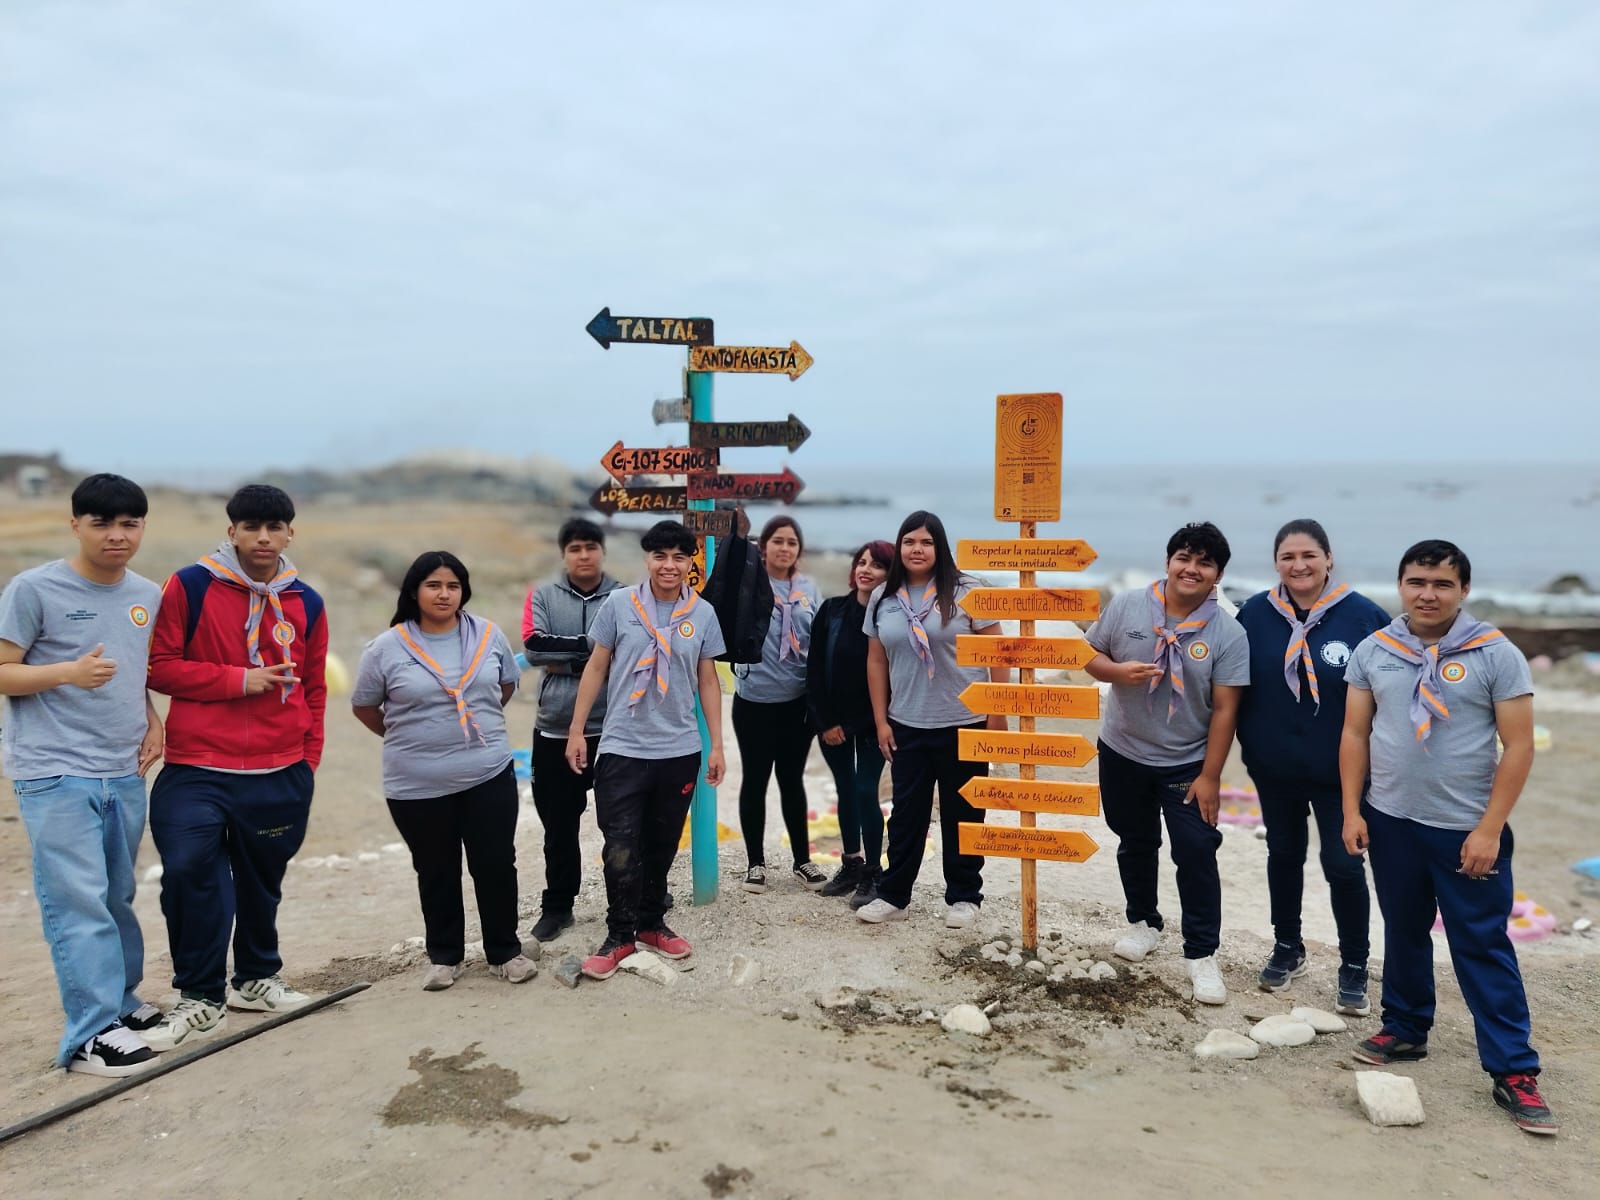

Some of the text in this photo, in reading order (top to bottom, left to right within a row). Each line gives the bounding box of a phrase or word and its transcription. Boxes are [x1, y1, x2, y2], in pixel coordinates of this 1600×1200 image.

[617, 318, 699, 341] TALTAL
[701, 349, 797, 369] ANTOFAGASTA
[611, 452, 715, 471] G-107 SCHOOL
[599, 487, 628, 504] LOS
[617, 493, 687, 511] PERALE
[972, 545, 1011, 558] Respetar
[1013, 545, 1022, 556] la
[988, 560, 1006, 568] eres
[1008, 560, 1018, 568] su
[974, 593, 1011, 614] Reduce,
[1053, 594, 1085, 612] recicla.
[970, 652, 1081, 666] Tu responsabilidad.
[984, 687, 1073, 704] Cuidar la playa,
[993, 702, 1064, 716] es de todos.
[973, 742, 1076, 759] ¡No mas plásticos!
[974, 786, 986, 798] La
[987, 788, 1014, 800] arena
[1017, 791, 1029, 801] no
[1032, 793, 1041, 803] es
